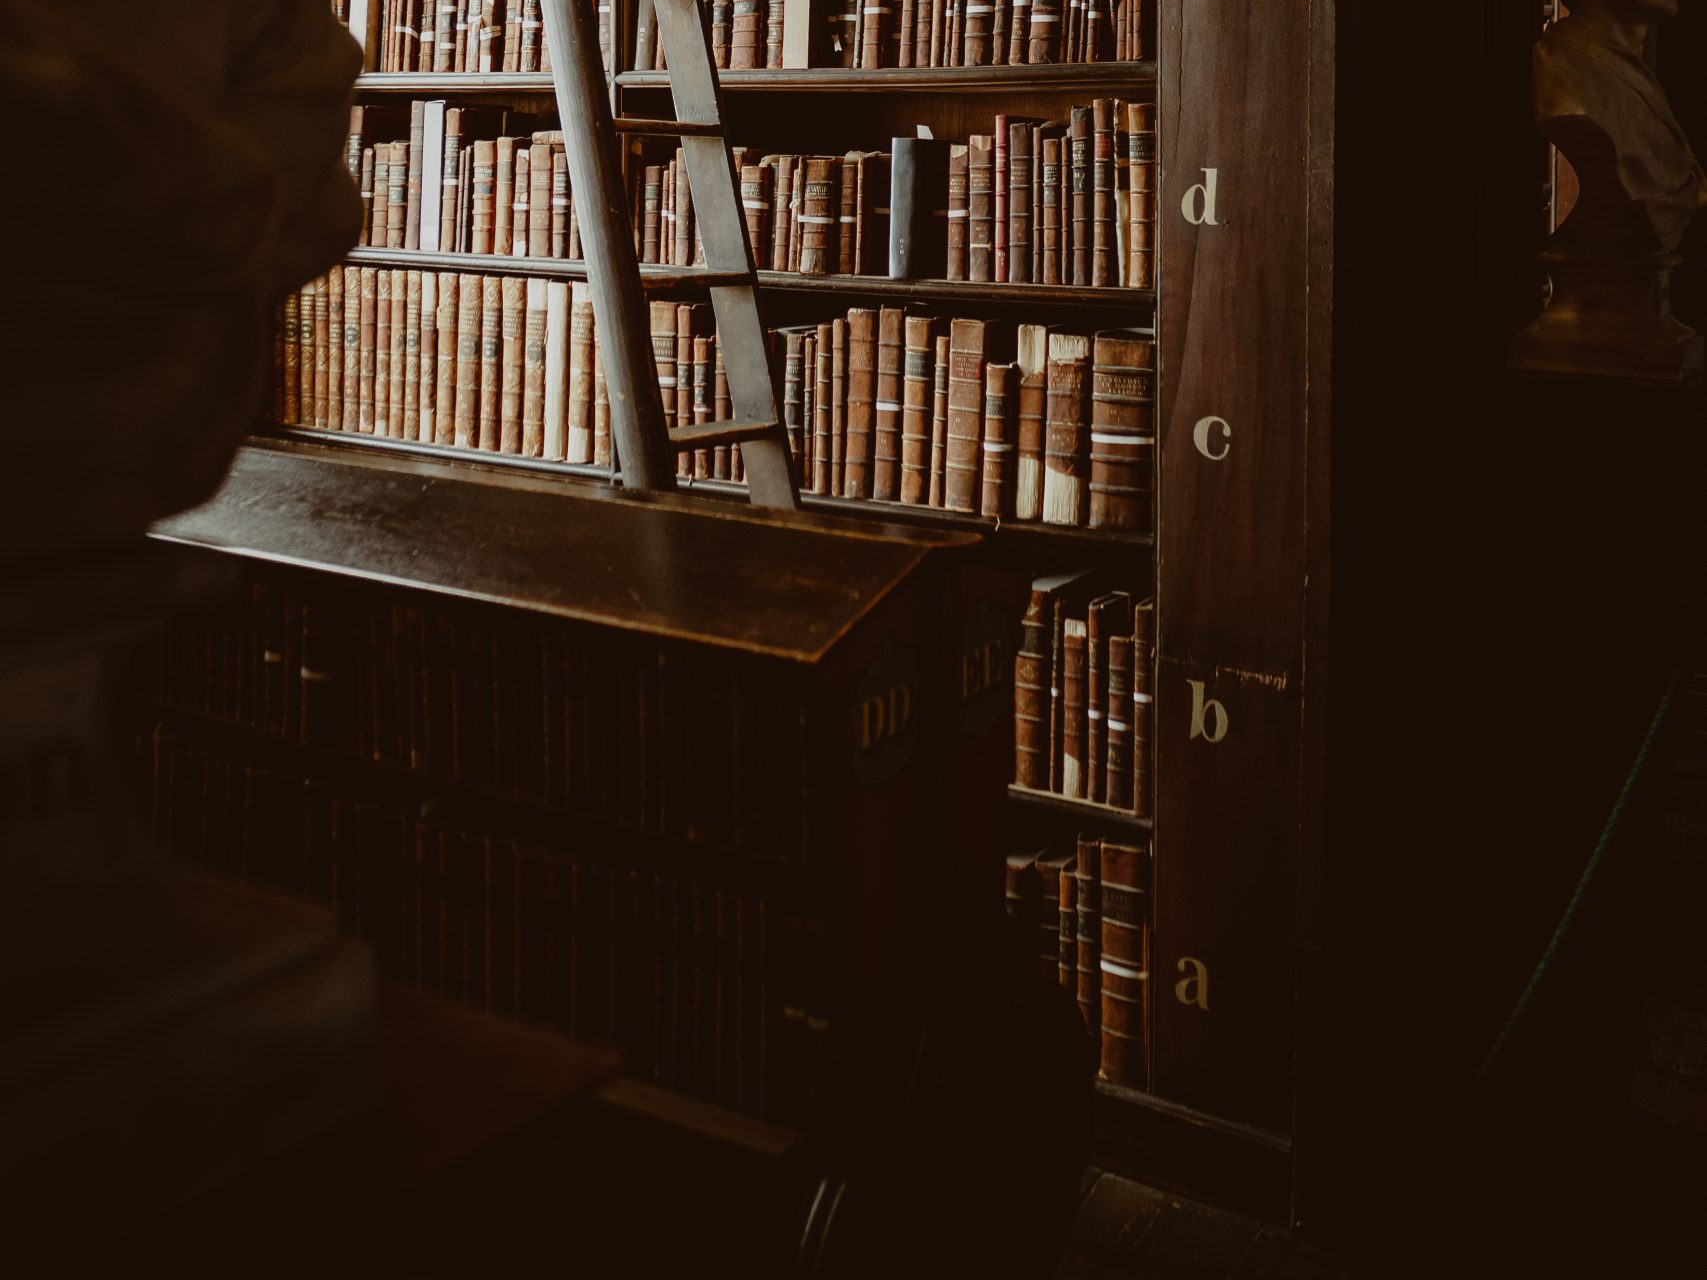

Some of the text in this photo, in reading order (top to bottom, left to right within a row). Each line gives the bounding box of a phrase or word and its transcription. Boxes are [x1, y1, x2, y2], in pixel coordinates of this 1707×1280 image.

[1181, 168, 1219, 225] d
[1193, 415, 1232, 460] c
[862, 686, 910, 750] DD
[1186, 679, 1229, 744] b
[1174, 955, 1210, 1013] a
